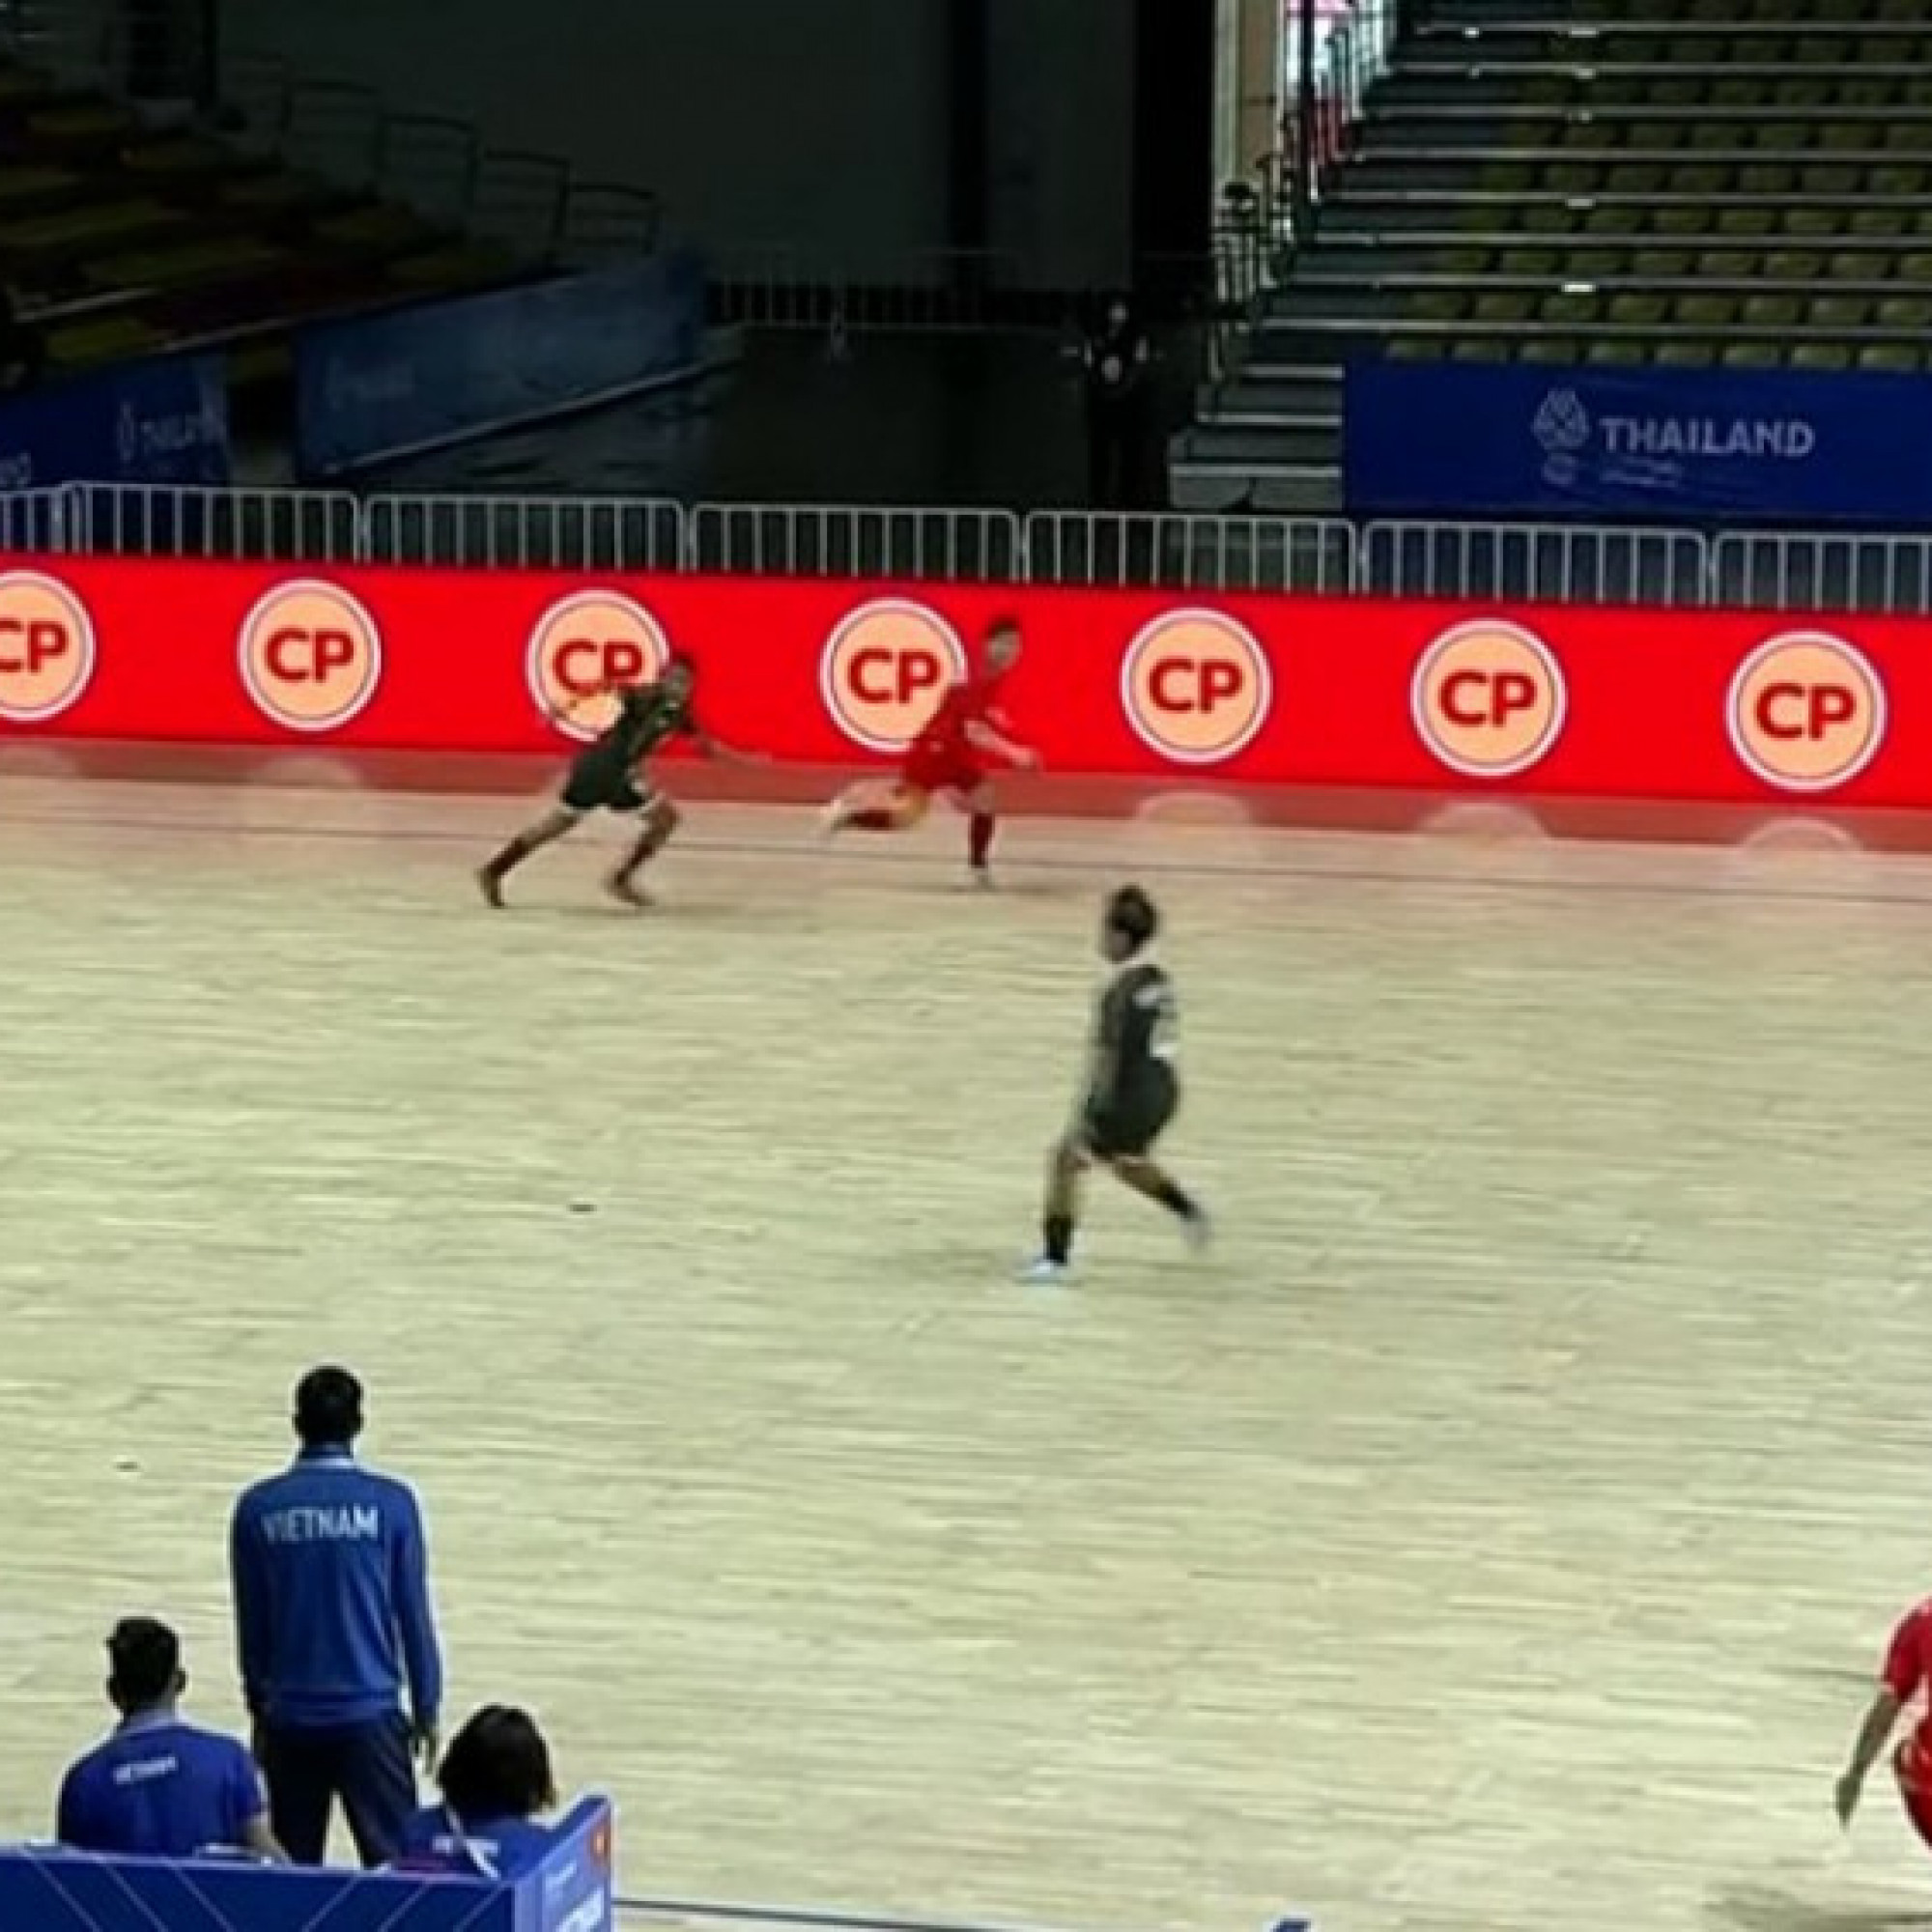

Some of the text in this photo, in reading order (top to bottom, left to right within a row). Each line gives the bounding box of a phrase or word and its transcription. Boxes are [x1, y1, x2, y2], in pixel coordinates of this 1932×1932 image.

[1599, 416, 1816, 458] THAILAND
[264, 628, 355, 683] CP
[552, 639, 644, 695] CP
[846, 648, 941, 705] CP
[1148, 658, 1243, 715] CP
[1437, 669, 1537, 728] CP
[1753, 682, 1857, 742] CP
[261, 1502, 379, 1544] VIETNAM
